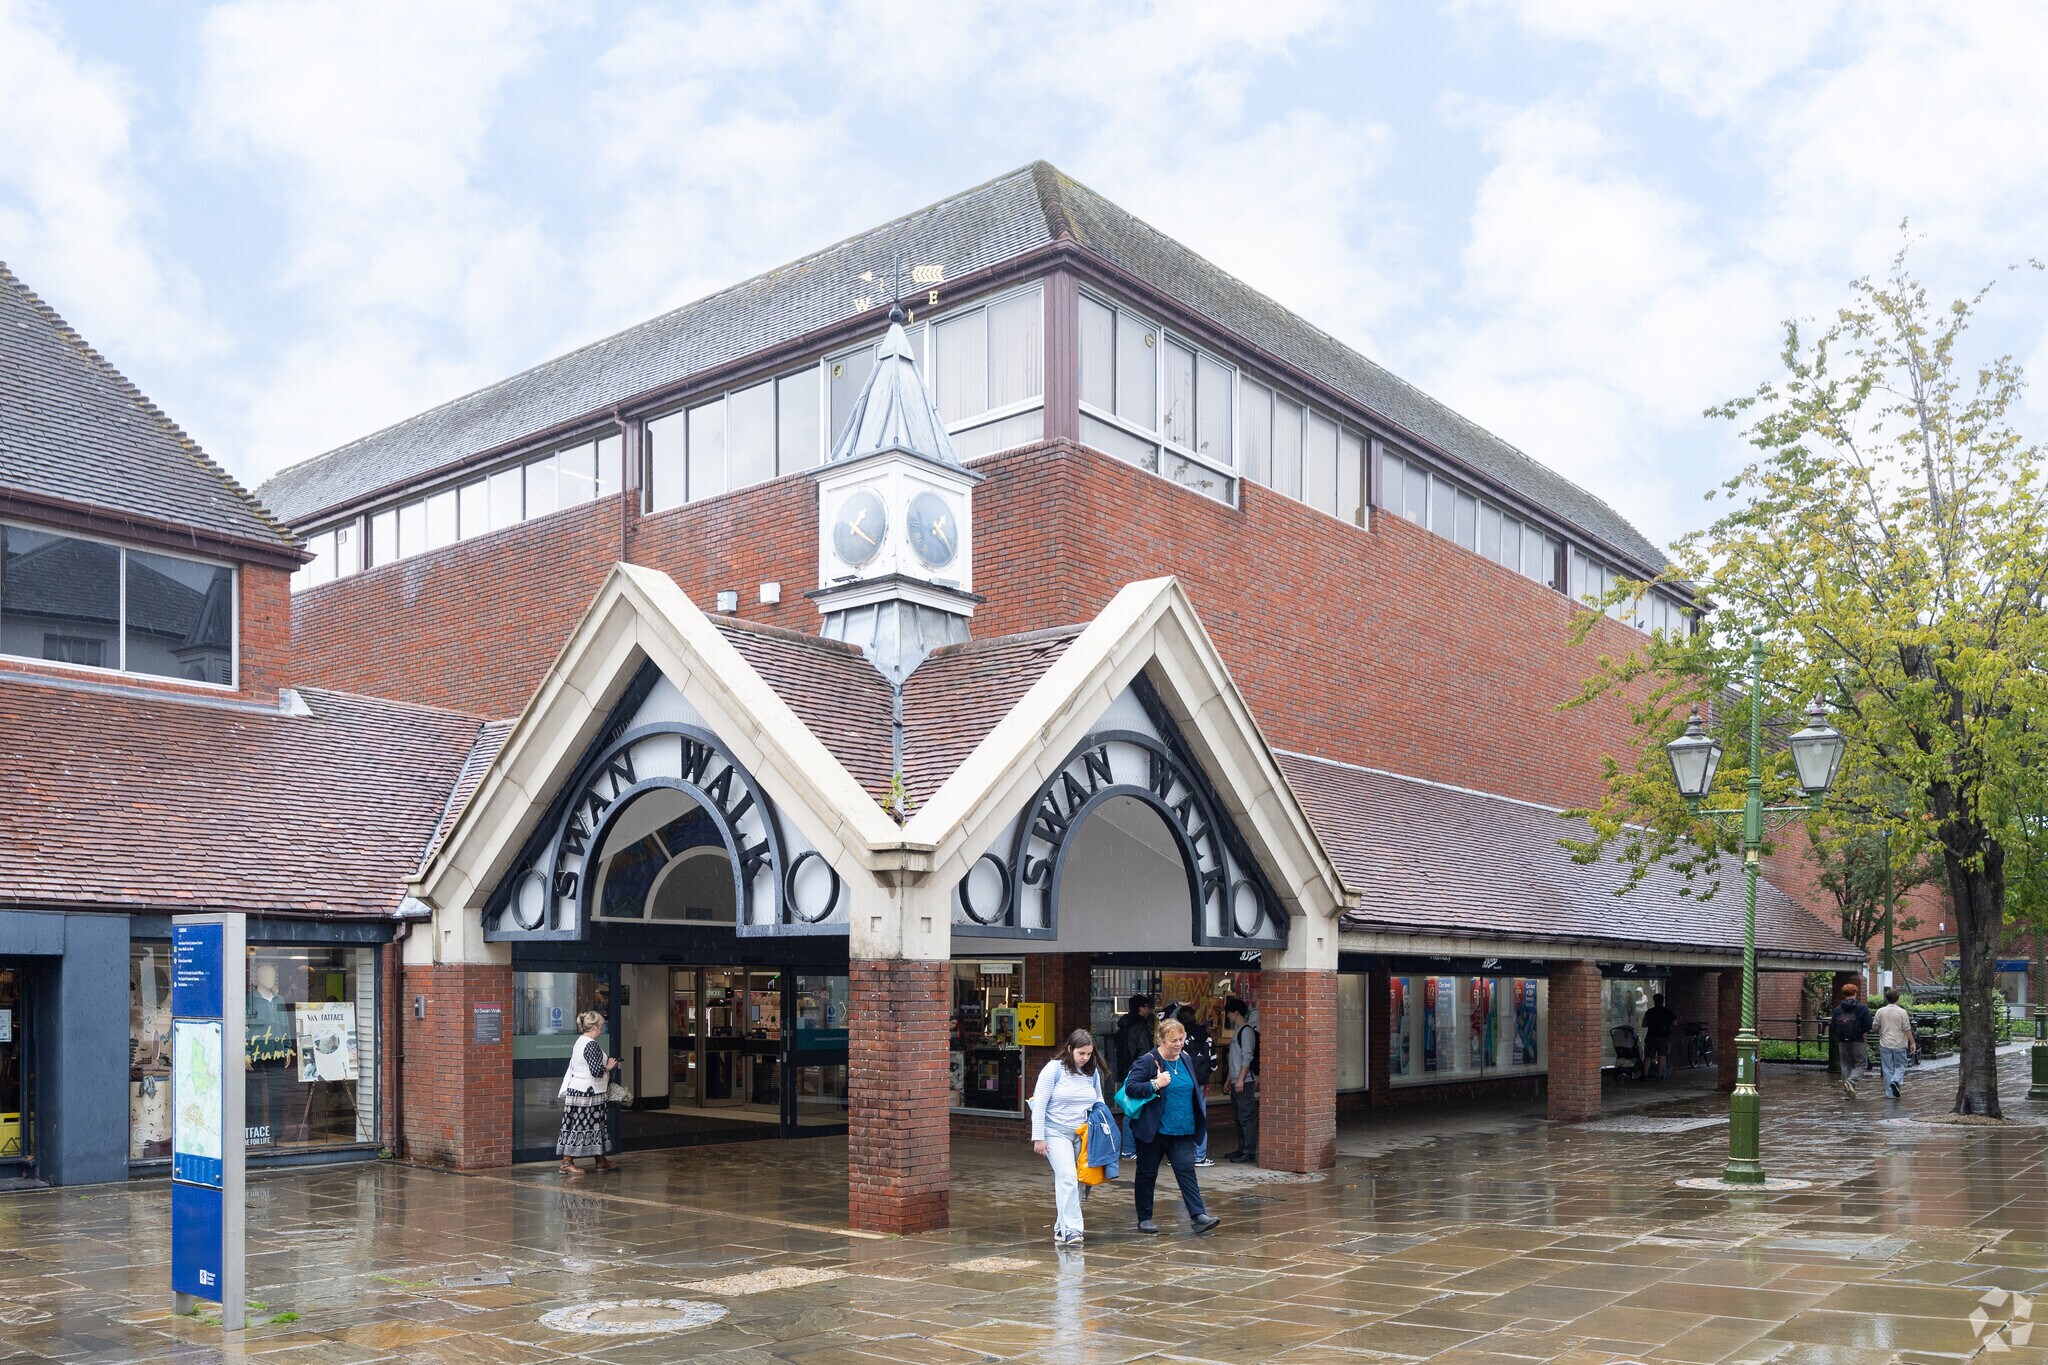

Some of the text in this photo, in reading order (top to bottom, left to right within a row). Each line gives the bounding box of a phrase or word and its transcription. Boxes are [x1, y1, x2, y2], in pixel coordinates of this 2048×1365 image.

[853, 296, 871, 313] W
[928, 290, 939, 305] E
[553, 736, 775, 900] SWAN WALK
[1022, 745, 1226, 905] SWAN WALK
[320, 1013, 345, 1021] FATFACE
[244, 1025, 288, 1046] rt of
[245, 1045, 297, 1063] tumn
[244, 1126, 271, 1139] TFACE
